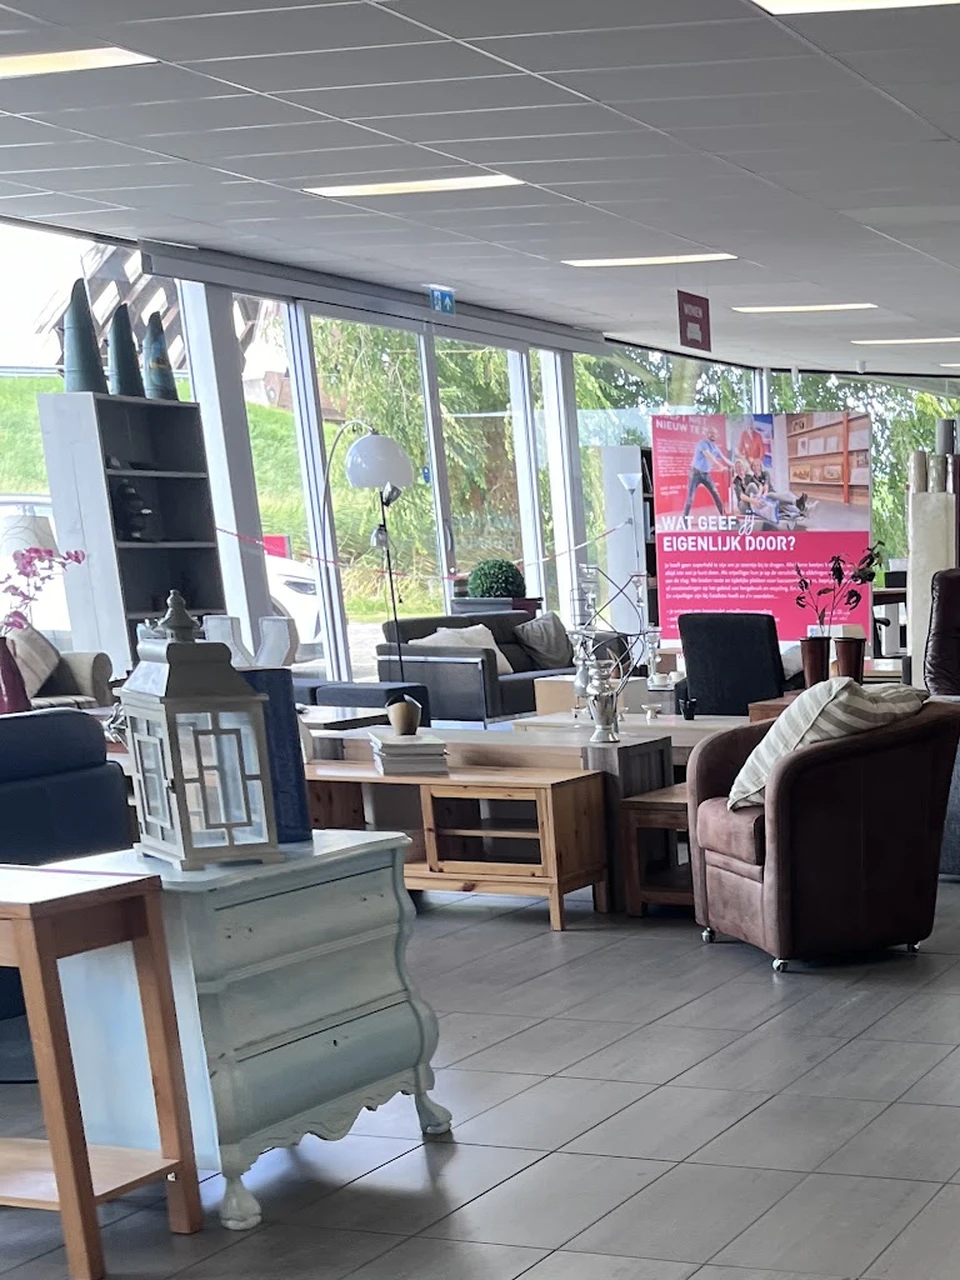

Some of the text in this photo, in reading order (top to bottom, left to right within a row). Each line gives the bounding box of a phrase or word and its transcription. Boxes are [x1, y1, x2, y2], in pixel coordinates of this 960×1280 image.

[656, 419, 688, 432] NIEUW
[661, 515, 694, 531] WAT
[698, 515, 737, 531] GEEF
[662, 535, 796, 552] EIGENLIJK DOOR?
